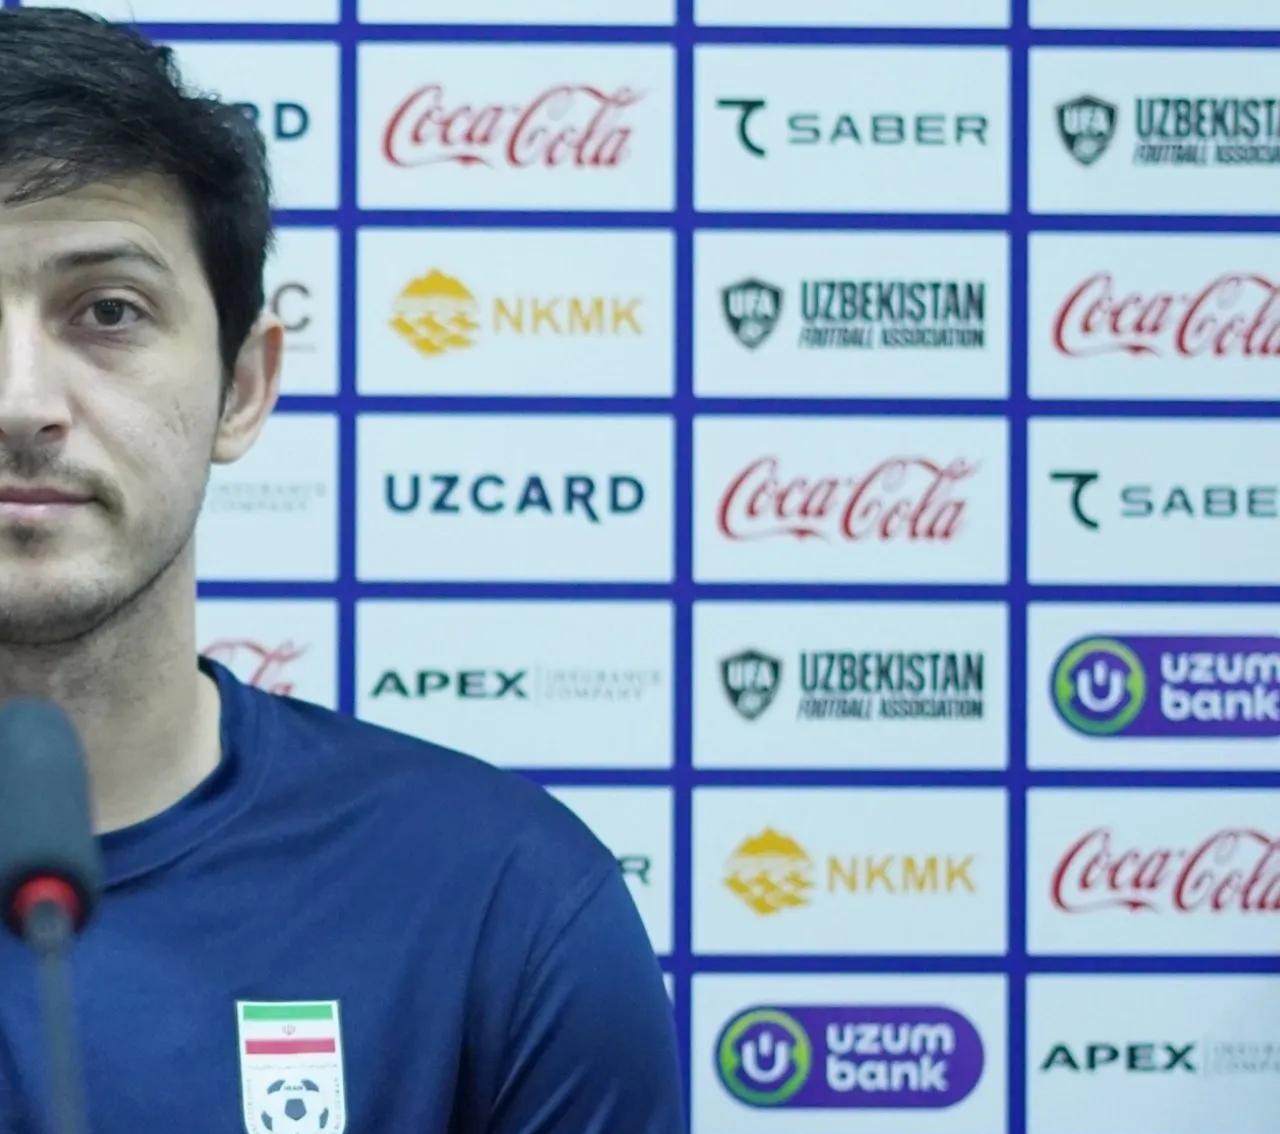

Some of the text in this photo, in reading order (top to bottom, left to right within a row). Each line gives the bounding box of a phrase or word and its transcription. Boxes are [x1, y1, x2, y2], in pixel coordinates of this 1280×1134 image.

[787, 113, 990, 146] SABER
[1136, 97, 1280, 138] UZBEKIST
[494, 297, 640, 333] NKMK
[801, 280, 986, 324] UZBEKISTAN
[384, 473, 646, 524] UZCARD
[370, 669, 527, 699] APEX
[800, 651, 985, 695] UZBEKISTAN
[1161, 652, 1280, 684] uzum
[1160, 684, 1280, 721] bank
[828, 856, 973, 892] NKMK
[826, 1023, 955, 1056] uzum
[1040, 1042, 1197, 1073] APEX
[826, 1053, 947, 1092] bank
